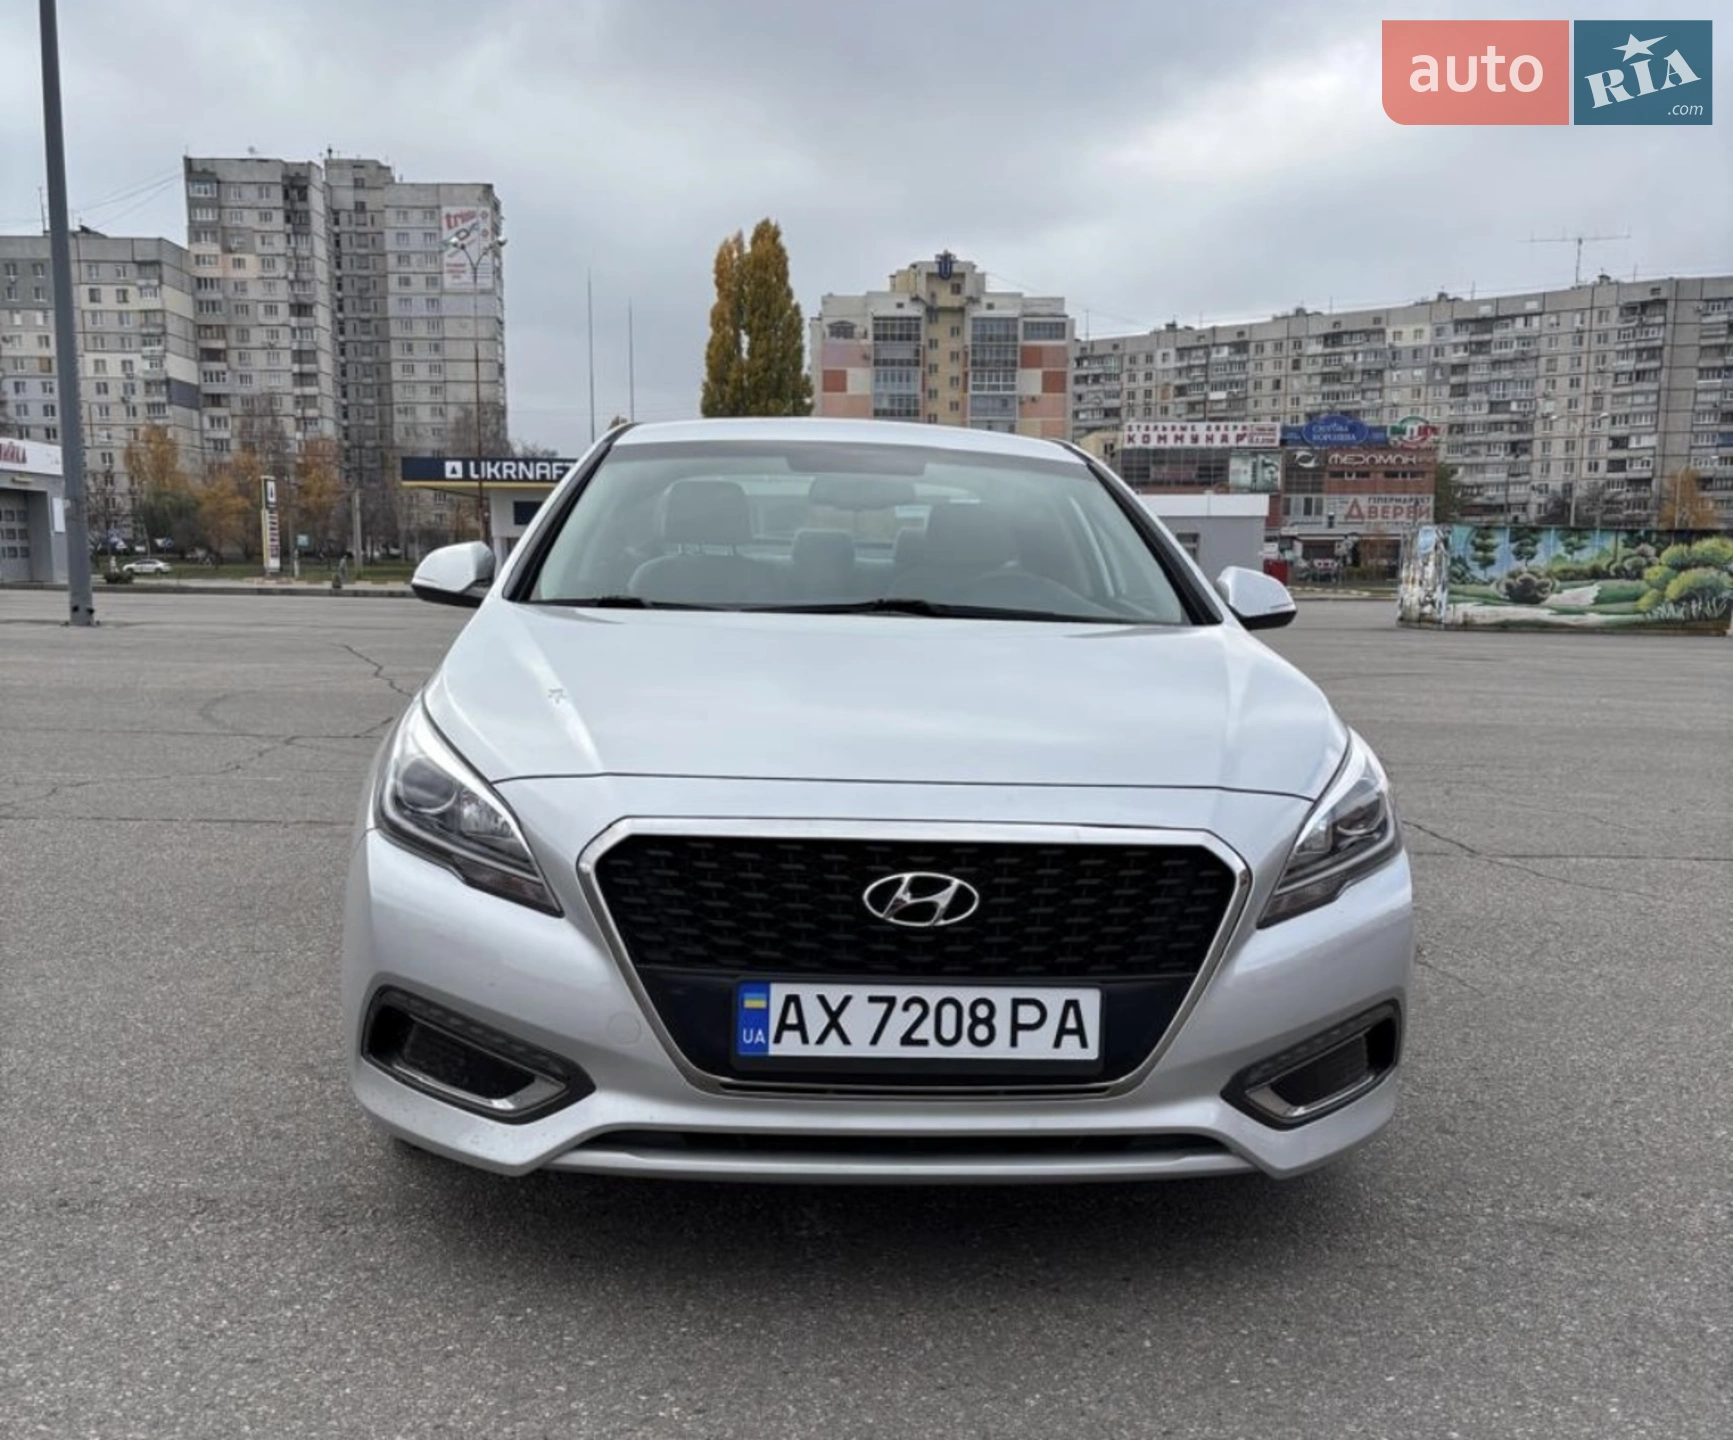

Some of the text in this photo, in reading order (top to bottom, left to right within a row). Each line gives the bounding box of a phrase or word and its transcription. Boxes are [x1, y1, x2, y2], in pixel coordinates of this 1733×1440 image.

[1127, 433, 1245, 445] КОММУНАР
[772, 993, 1088, 1049] AX 7208 PA
[742, 1029, 766, 1045] UA
